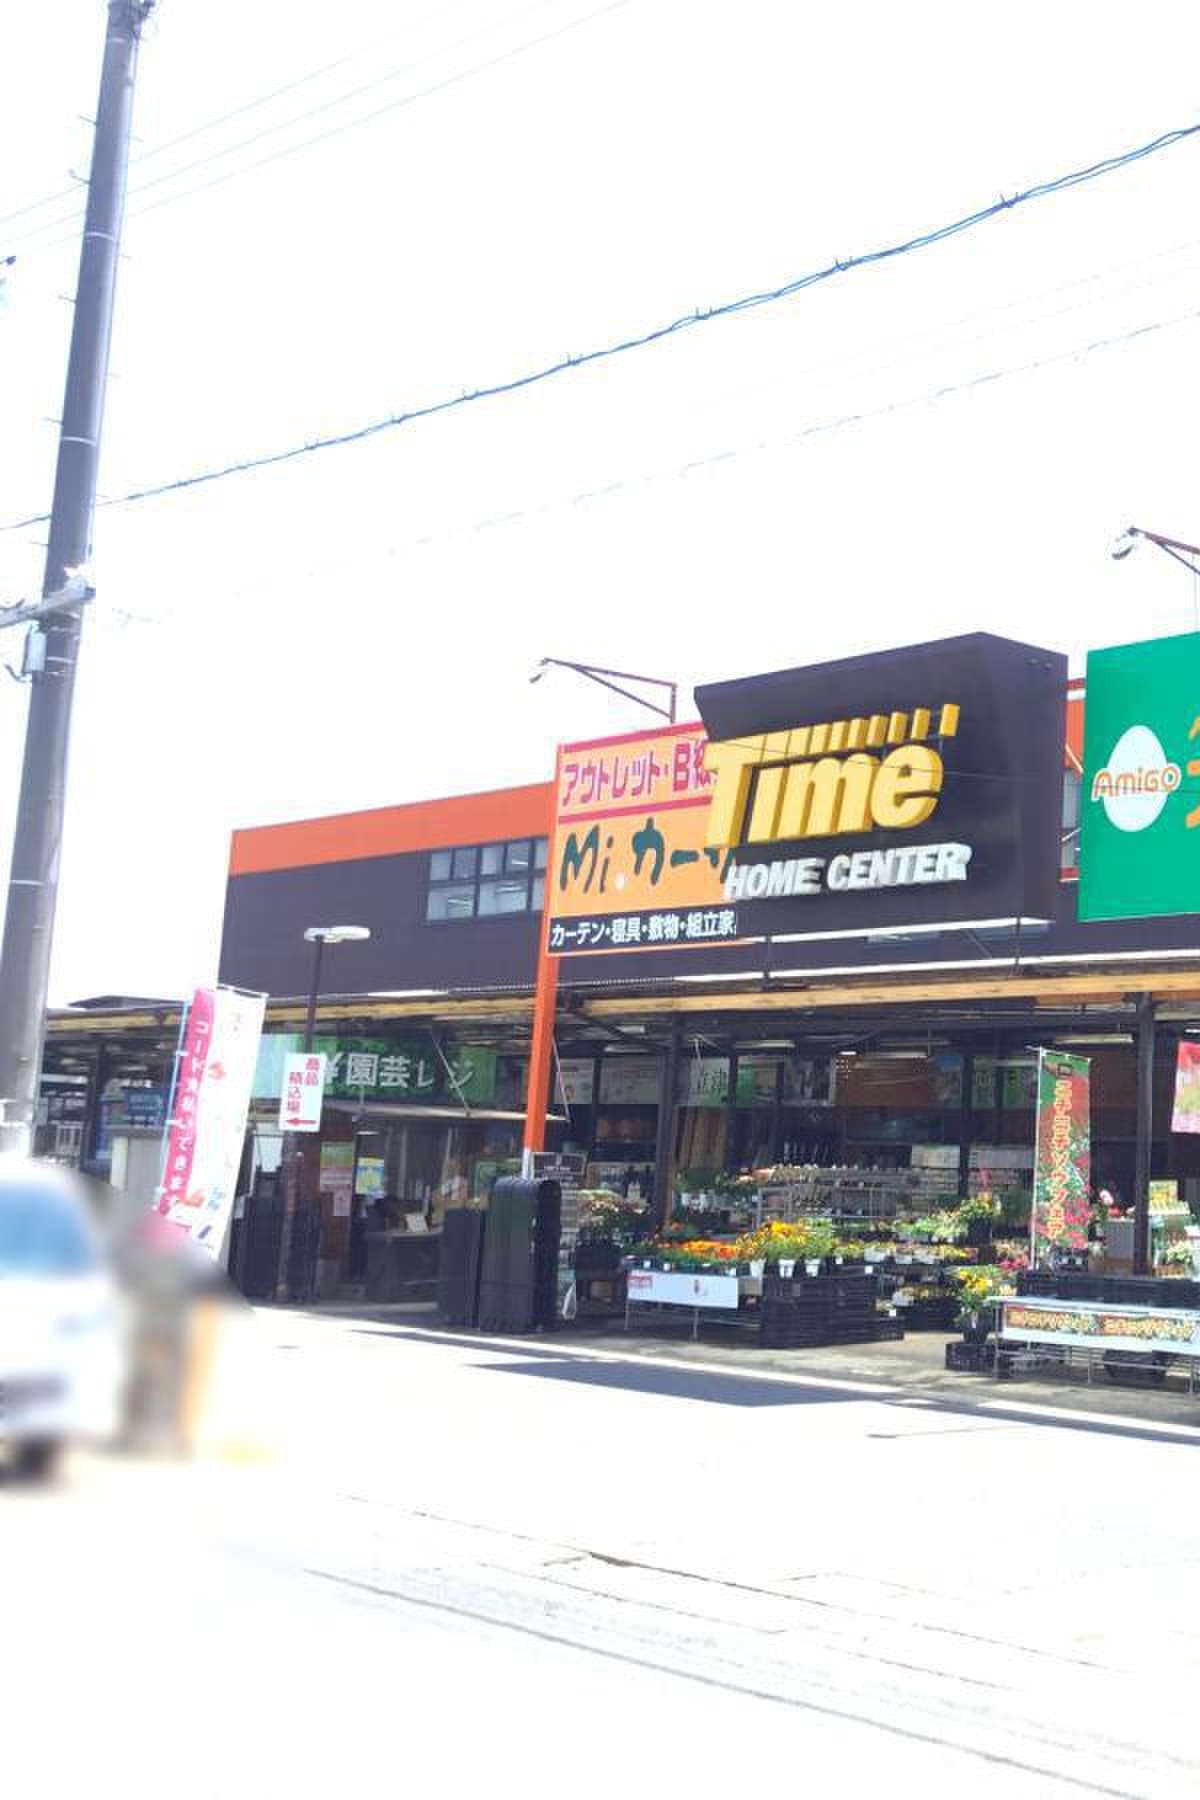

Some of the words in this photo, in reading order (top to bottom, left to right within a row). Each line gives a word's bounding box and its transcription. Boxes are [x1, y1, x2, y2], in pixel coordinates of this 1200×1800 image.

[704, 728, 945, 850] Time
[724, 857, 821, 900] HOME
[827, 843, 972, 891] CENTER
[551, 909, 736, 947] カーテン・寝具・敷物・組立家
